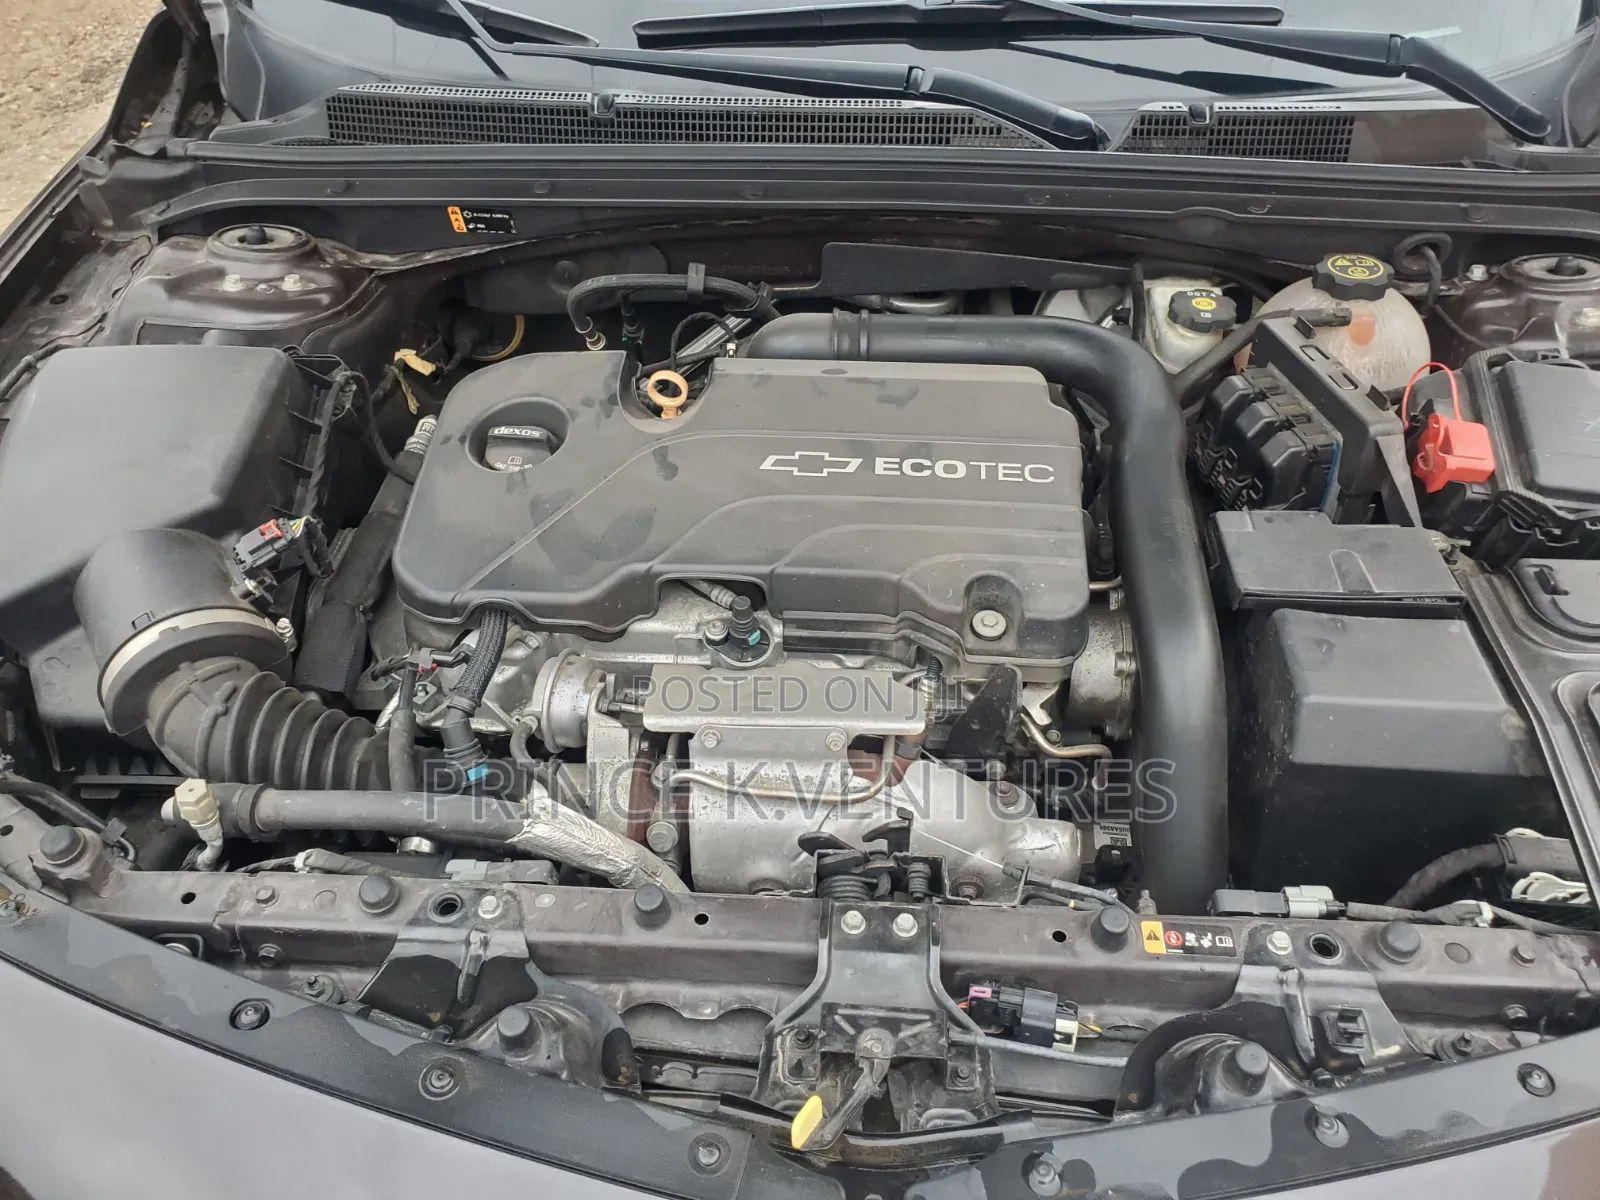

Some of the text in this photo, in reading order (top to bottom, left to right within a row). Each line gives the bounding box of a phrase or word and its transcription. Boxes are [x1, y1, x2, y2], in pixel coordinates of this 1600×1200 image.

[494, 426, 543, 437] dexos
[494, 461, 507, 470] SAE
[874, 456, 1055, 484] ECOTEC
